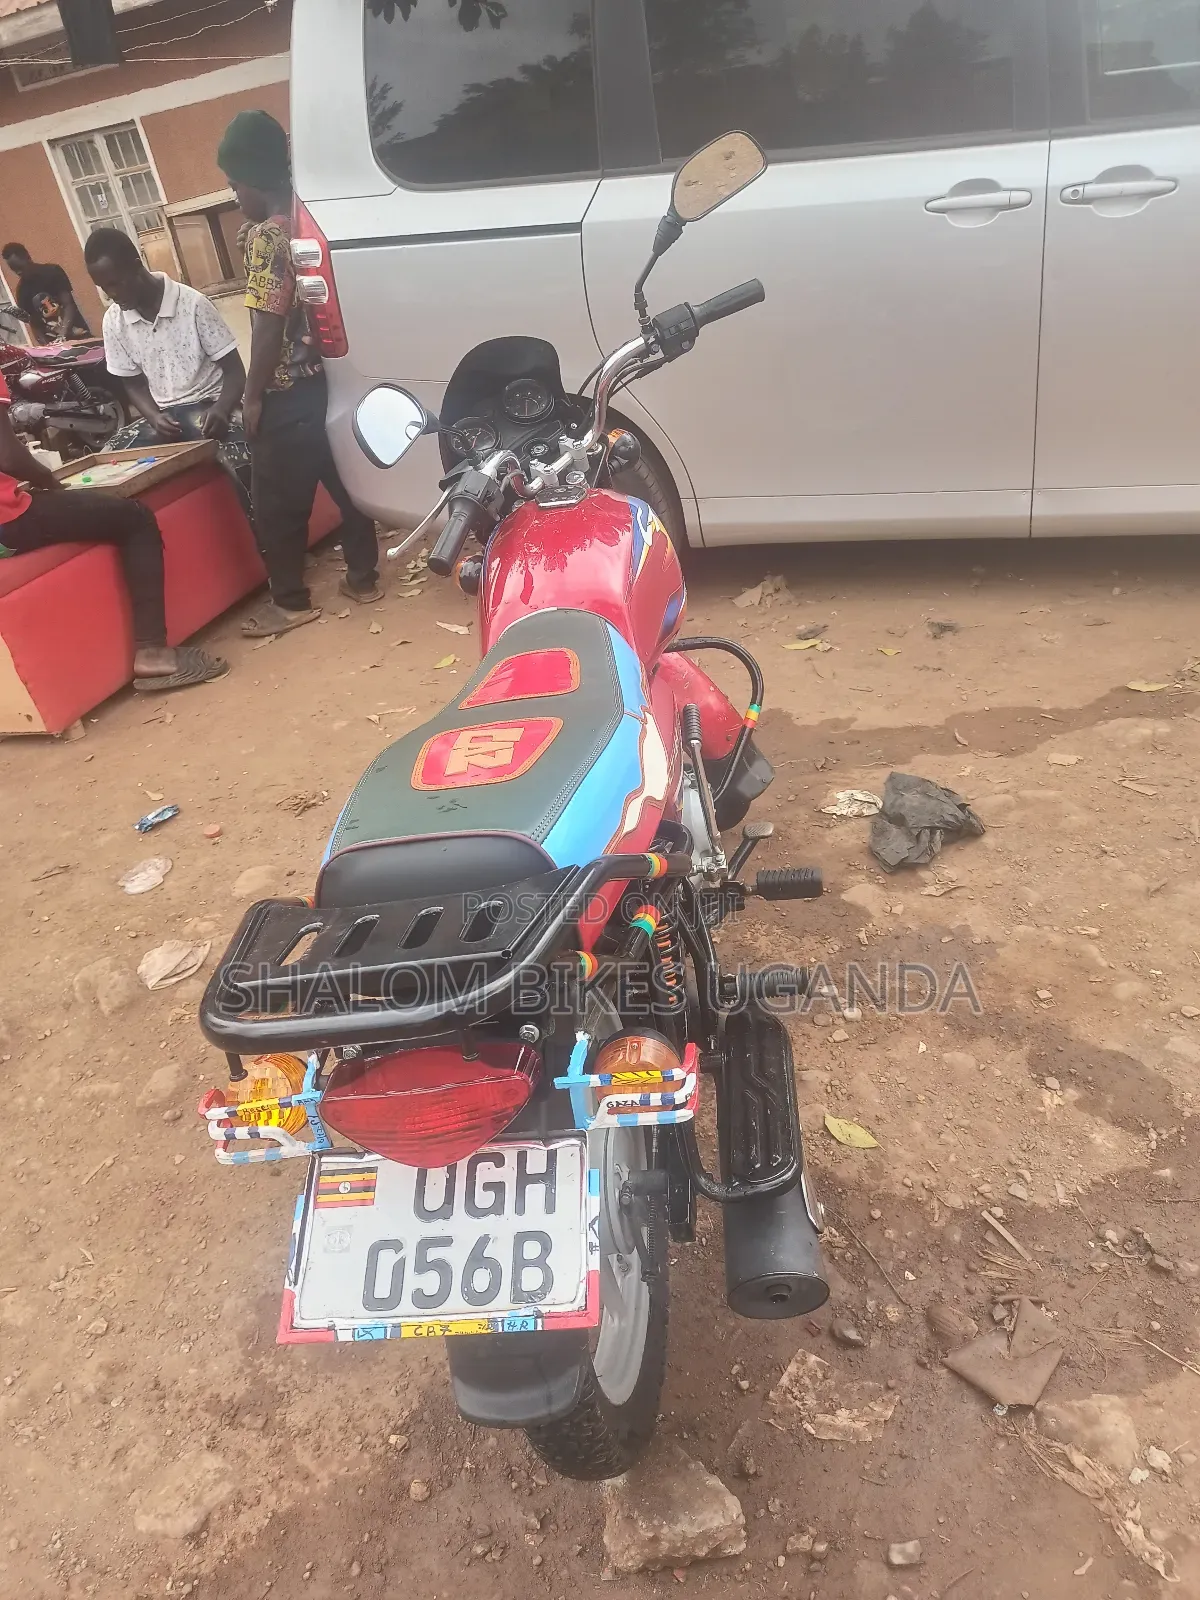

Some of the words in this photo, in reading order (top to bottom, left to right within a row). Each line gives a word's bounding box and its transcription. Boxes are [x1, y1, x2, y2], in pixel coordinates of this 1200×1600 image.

[606, 1099, 640, 1109] GAZA
[413, 1148, 558, 1223] UGH
[361, 1230, 555, 1312] 056B
